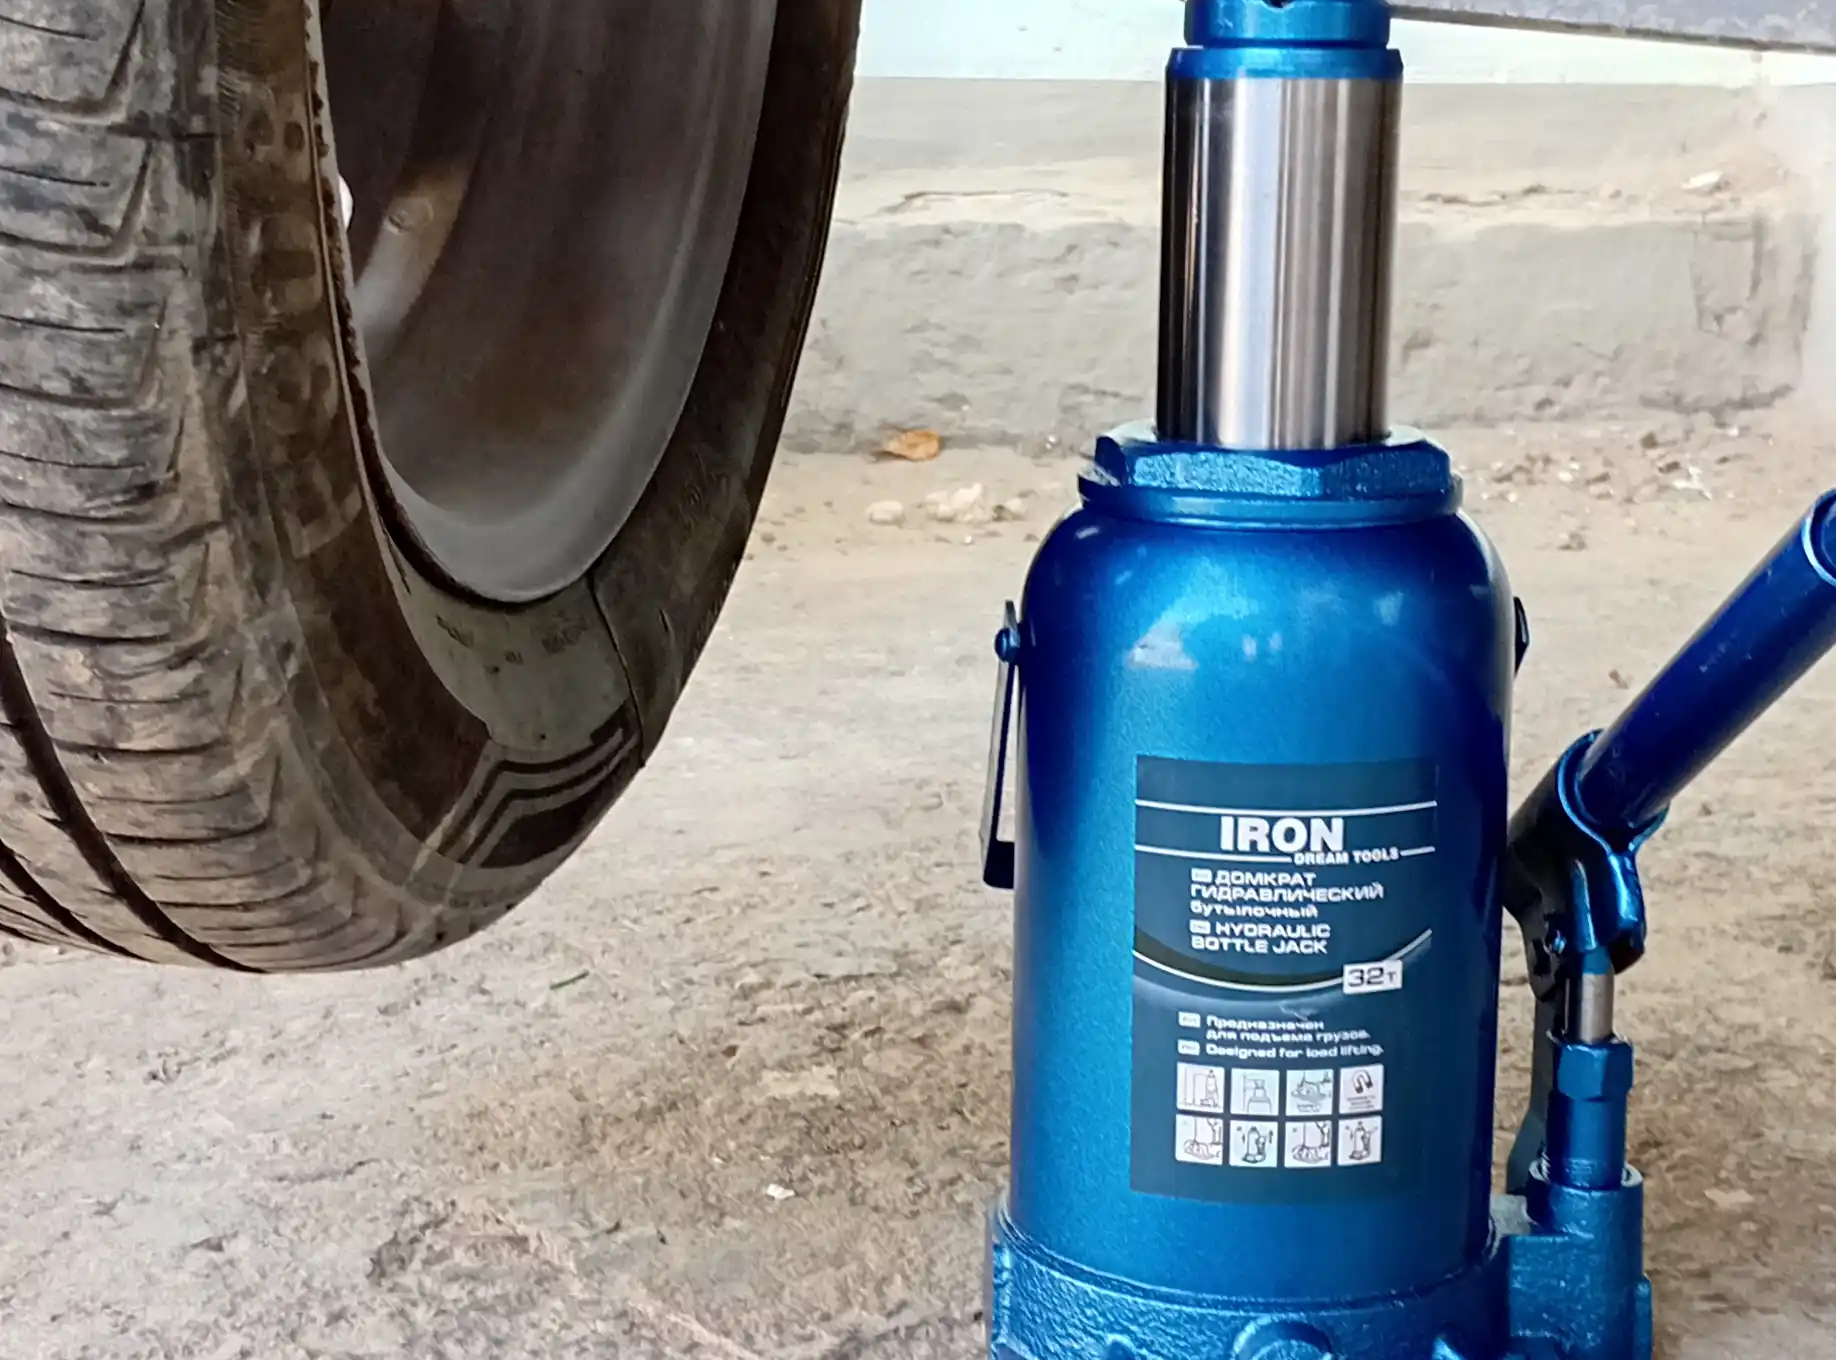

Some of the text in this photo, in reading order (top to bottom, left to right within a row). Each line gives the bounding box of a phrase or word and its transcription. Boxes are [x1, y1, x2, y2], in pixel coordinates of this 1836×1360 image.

[1220, 815, 1345, 853] IRON
[1294, 847, 1400, 865] DREAM TOOLS
[1215, 871, 1316, 887] ДОМКРАТ
[1190, 882, 1384, 902] ГИДРАВЛИЧЕСКИЙ
[1190, 901, 1318, 919] бутылочный
[1215, 921, 1331, 938] HYDRAULIC
[1191, 936, 1328, 954] BOTTLE JACK
[1206, 1014, 1325, 1031] Предназначен
[1206, 1028, 1237, 1041] для
[1206, 1043, 1276, 1059] Designed
[1279, 1046, 1304, 1058] for
[1306, 1045, 1338, 1058] load
